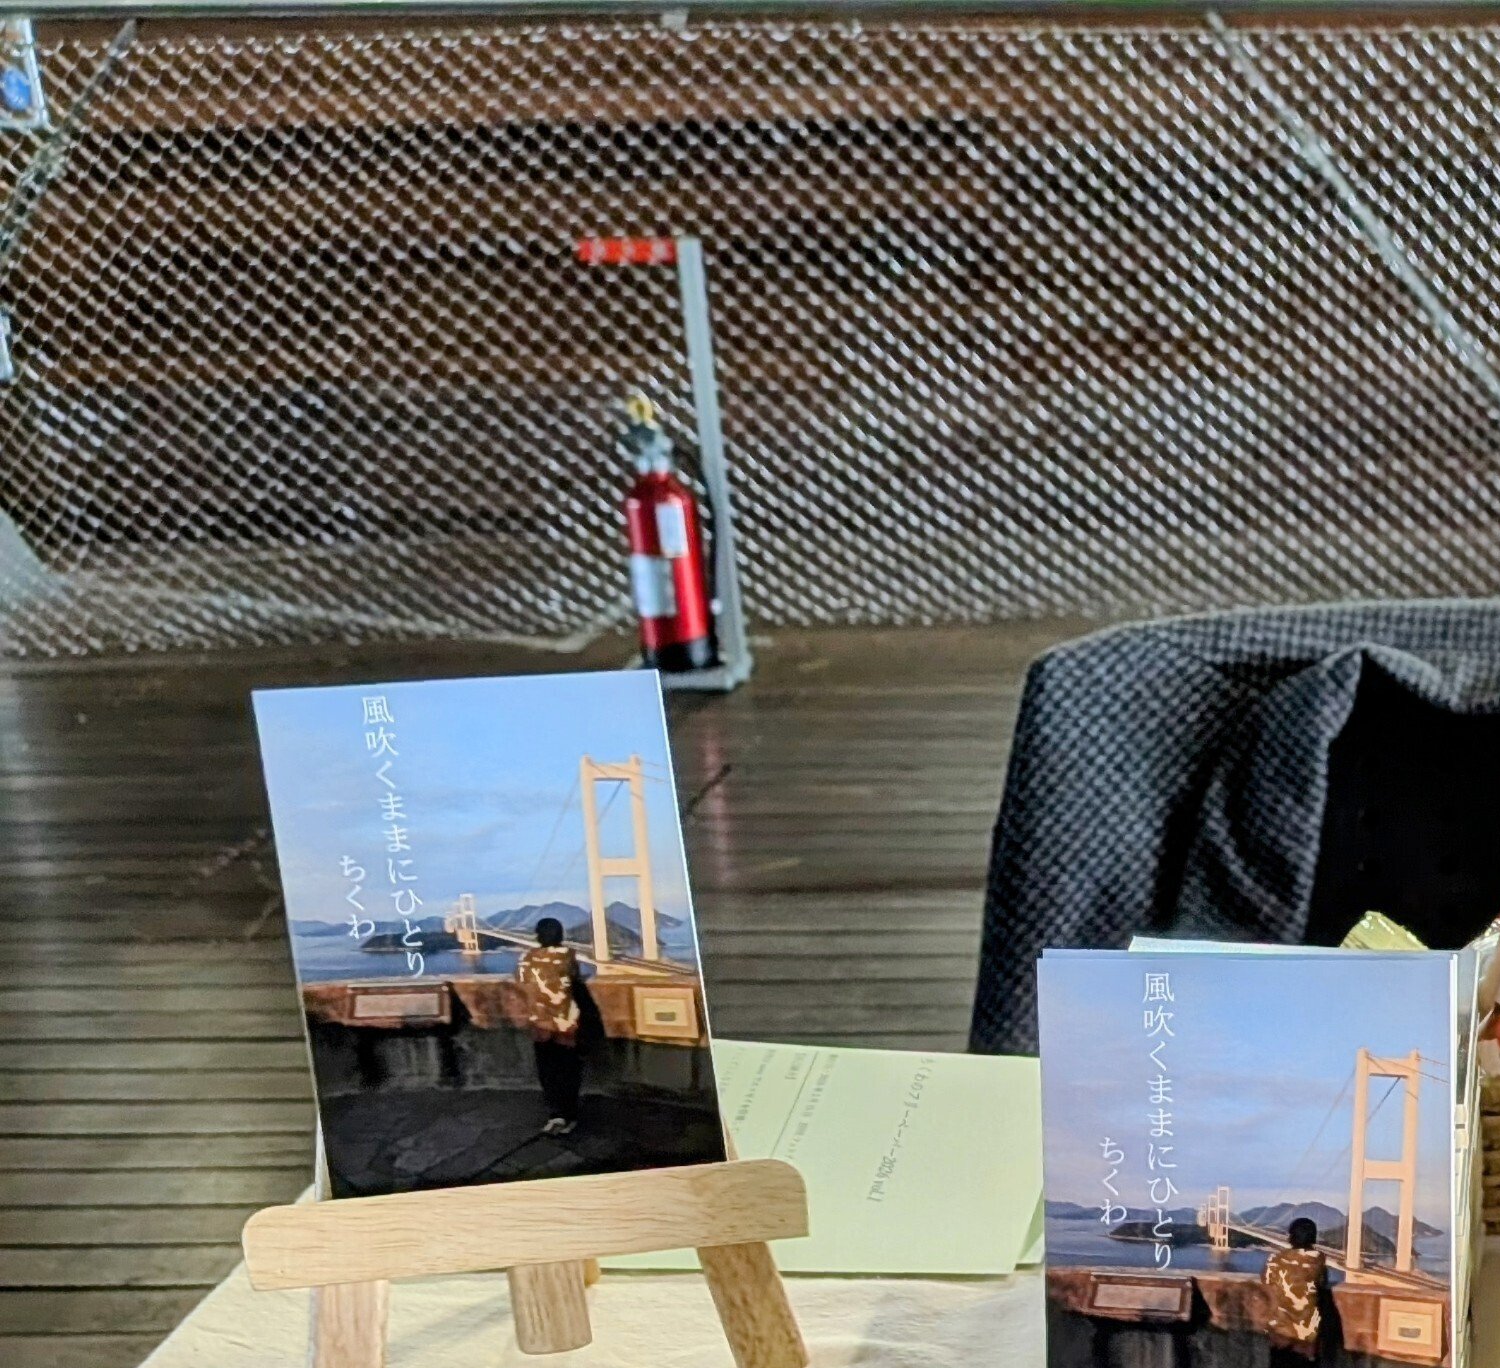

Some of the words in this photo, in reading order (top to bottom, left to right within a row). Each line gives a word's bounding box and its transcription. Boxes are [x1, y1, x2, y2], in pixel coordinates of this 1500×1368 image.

[338, 853, 376, 941] ちくわ
[361, 694, 426, 979] 風吹くままにひとり
[1098, 1137, 1127, 1225] ちくわ
[1143, 972, 1179, 1272] 風吹くままにひとり
